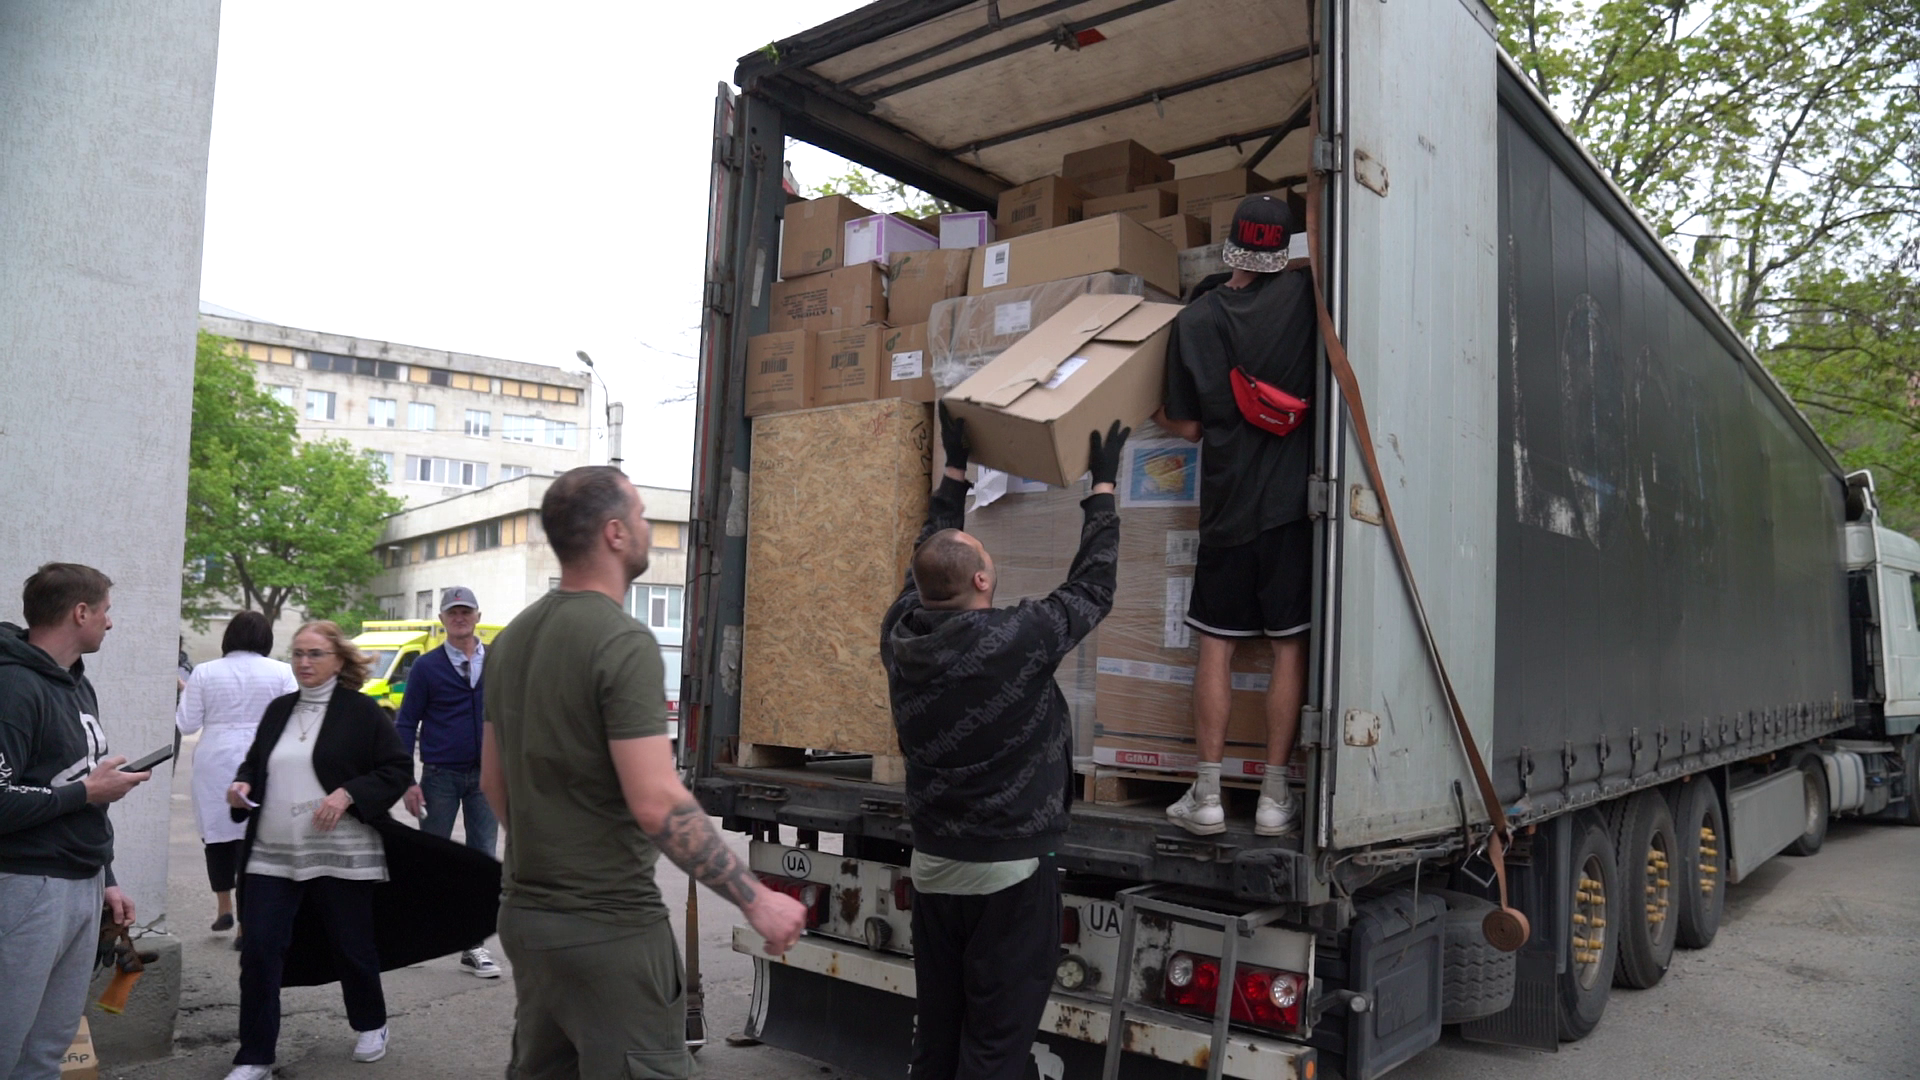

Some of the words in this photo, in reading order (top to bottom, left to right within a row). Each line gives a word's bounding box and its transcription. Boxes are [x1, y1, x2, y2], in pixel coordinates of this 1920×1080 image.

[1238, 219, 1284, 246] YMCMB
[1125, 753, 1157, 765] GIMA
[787, 855, 806, 873] UA
[1090, 904, 1121, 934] UA
